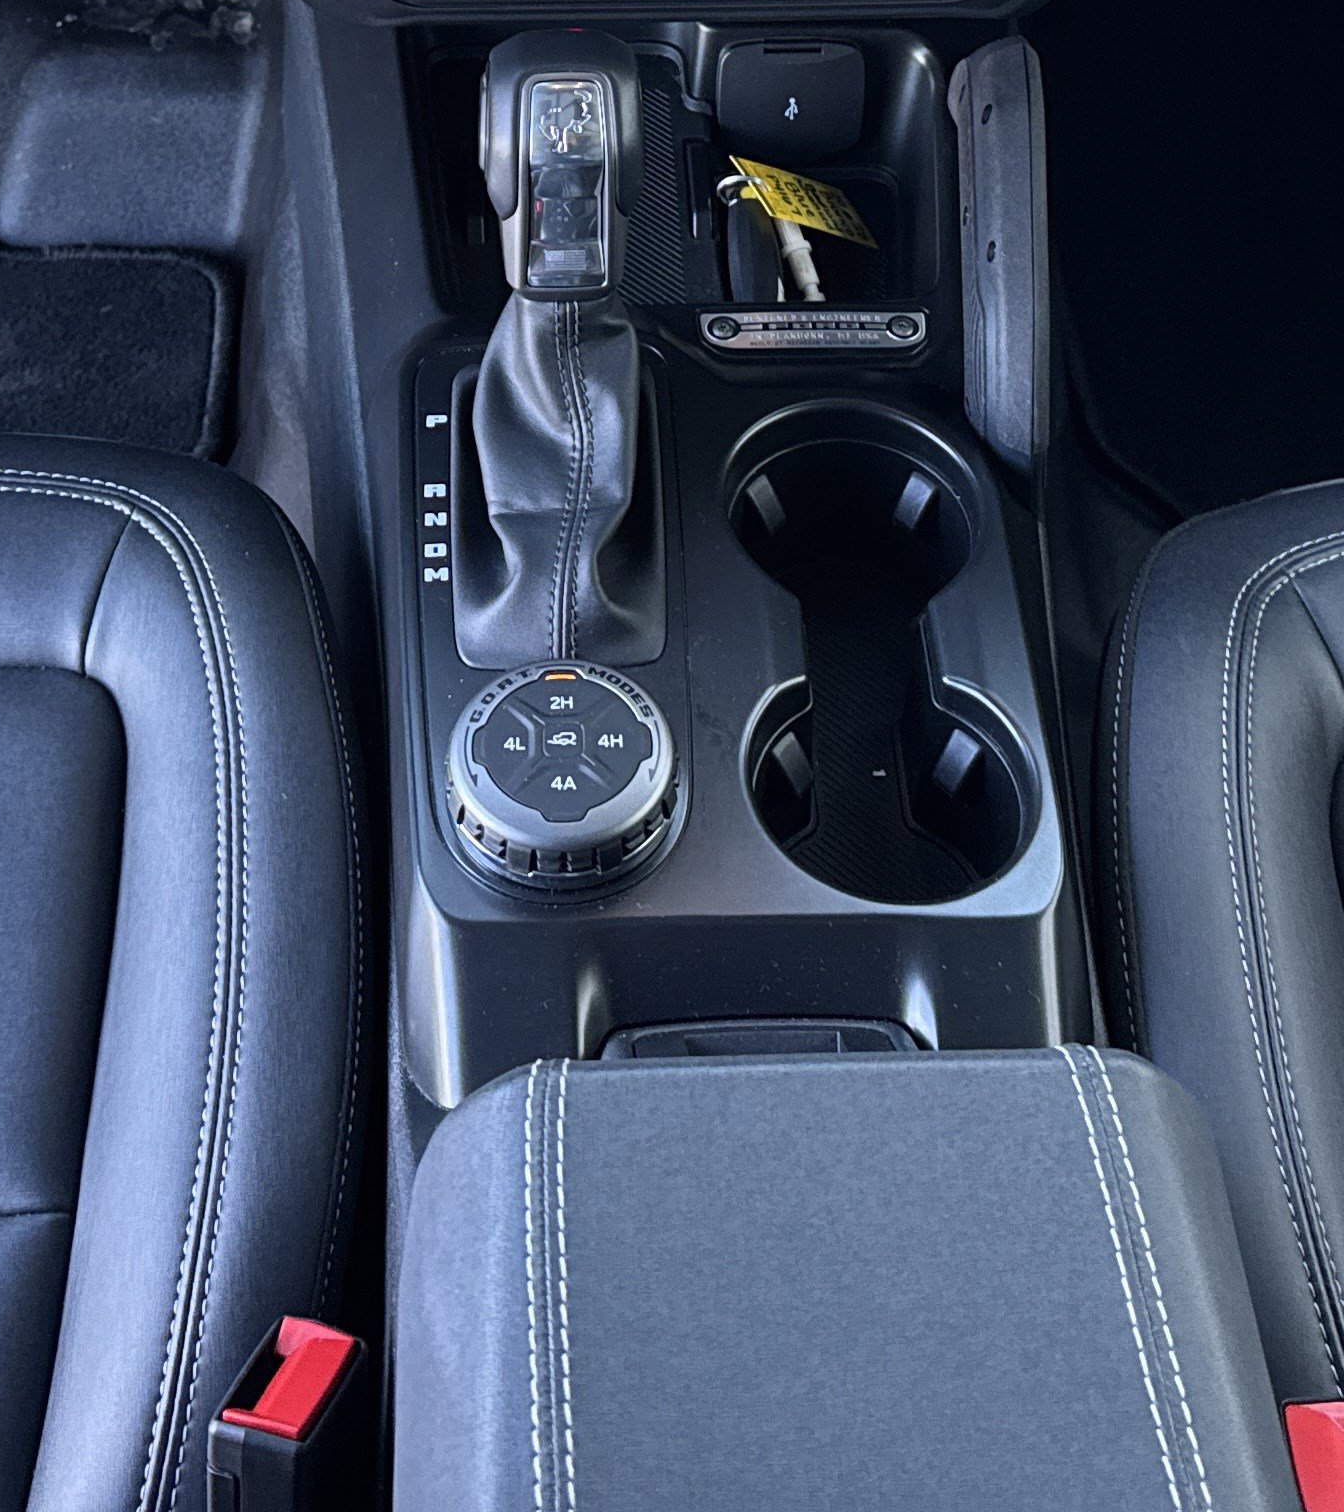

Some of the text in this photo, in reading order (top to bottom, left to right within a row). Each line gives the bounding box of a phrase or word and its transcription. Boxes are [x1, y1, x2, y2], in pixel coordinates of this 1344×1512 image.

[425, 414, 448, 427] P
[424, 512, 447, 527] N
[424, 567, 449, 582] M
[588, 666, 655, 718] MODES
[549, 695, 574, 710] 2H
[503, 737, 526, 751] 4L
[598, 734, 624, 748] 4H
[550, 776, 577, 790] 4A
